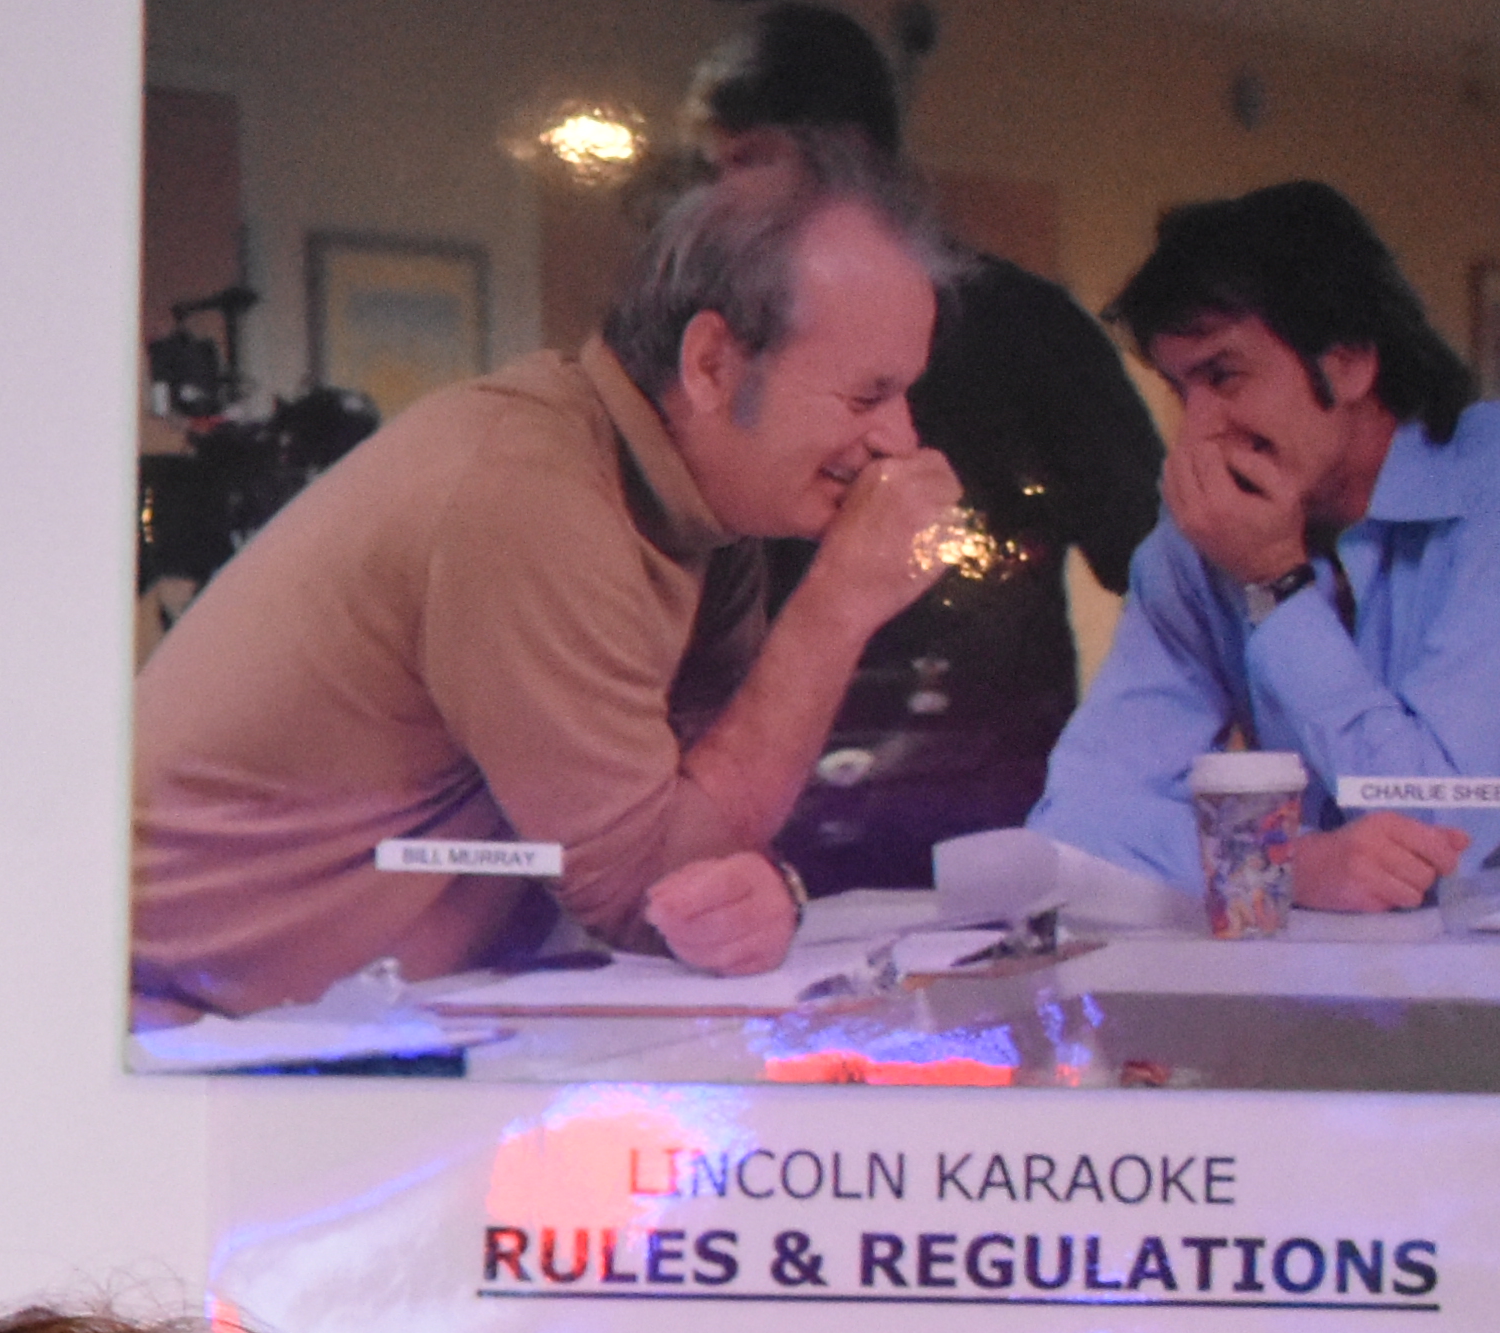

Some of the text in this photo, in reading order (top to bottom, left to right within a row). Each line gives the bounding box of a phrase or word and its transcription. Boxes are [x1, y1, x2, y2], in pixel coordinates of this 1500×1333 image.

[448, 848, 536, 866] MURRAY
[629, 1147, 1235, 1204] LINCOLN KARAOKE
[482, 1226, 1438, 1296] RULES & REGULATIONS
